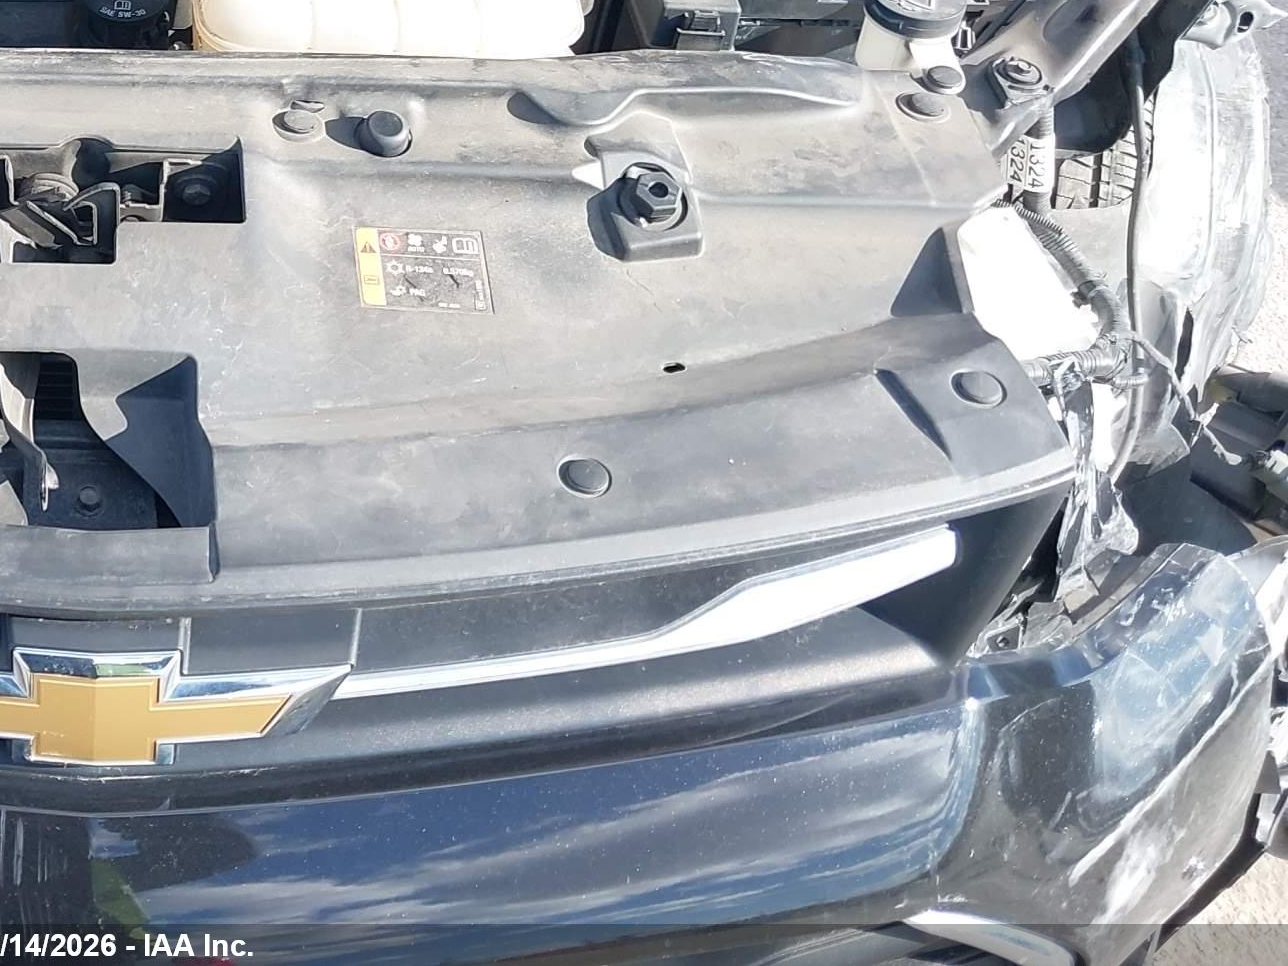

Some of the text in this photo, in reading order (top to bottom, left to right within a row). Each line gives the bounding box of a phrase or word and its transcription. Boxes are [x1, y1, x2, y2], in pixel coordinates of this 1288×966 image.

[99, 6, 147, 18] SAE 5W-30
[1028, 143, 1045, 188] 1324
